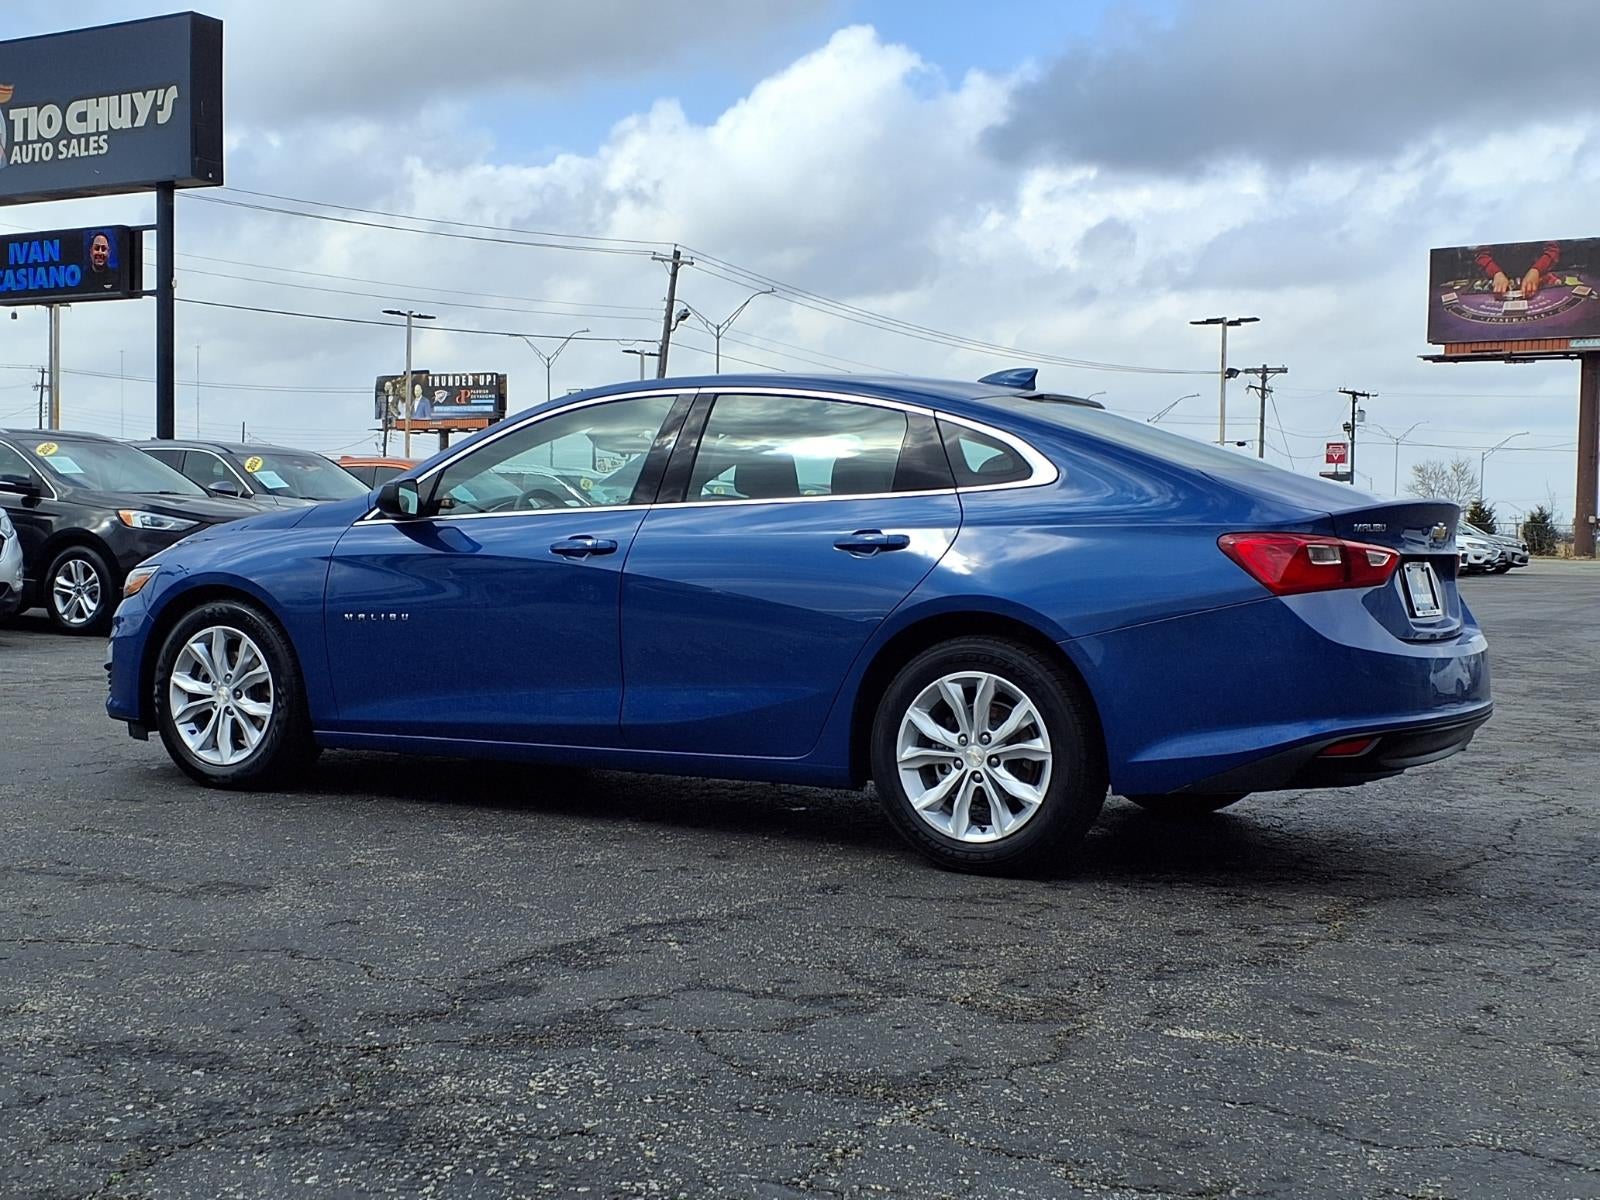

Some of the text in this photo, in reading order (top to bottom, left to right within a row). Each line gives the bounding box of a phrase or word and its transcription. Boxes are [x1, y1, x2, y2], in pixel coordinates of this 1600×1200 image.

[9, 85, 178, 142] TIO CHUY'S
[9, 135, 108, 165] AUTO SALES
[9, 240, 59, 264] IVAN
[428, 374, 496, 387] THUNDER UP!
[1353, 523, 1387, 532] MALIBU
[344, 613, 409, 621] MALIBU
